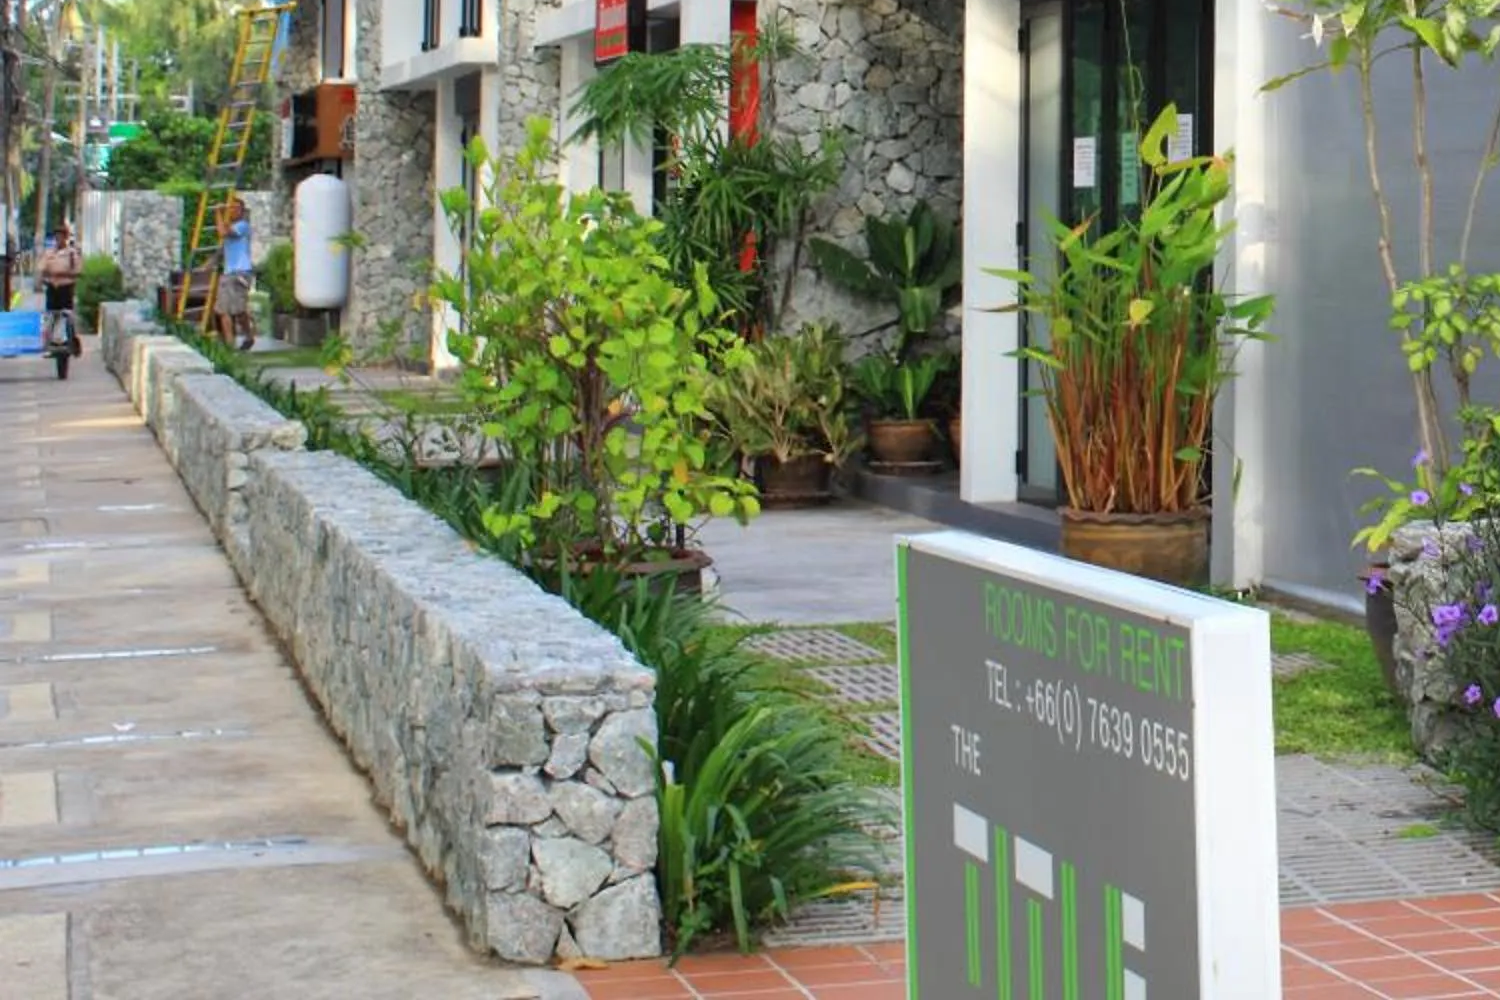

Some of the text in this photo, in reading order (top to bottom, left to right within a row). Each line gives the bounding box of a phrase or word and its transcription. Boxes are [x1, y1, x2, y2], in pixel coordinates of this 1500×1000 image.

[984, 578, 1186, 699] ROOMS FOR RENT
[951, 723, 981, 776] THE
[1025, 678, 1081, 751] +66(0)
[1087, 697, 1134, 759] 7639
[1140, 718, 1189, 781] 0555
